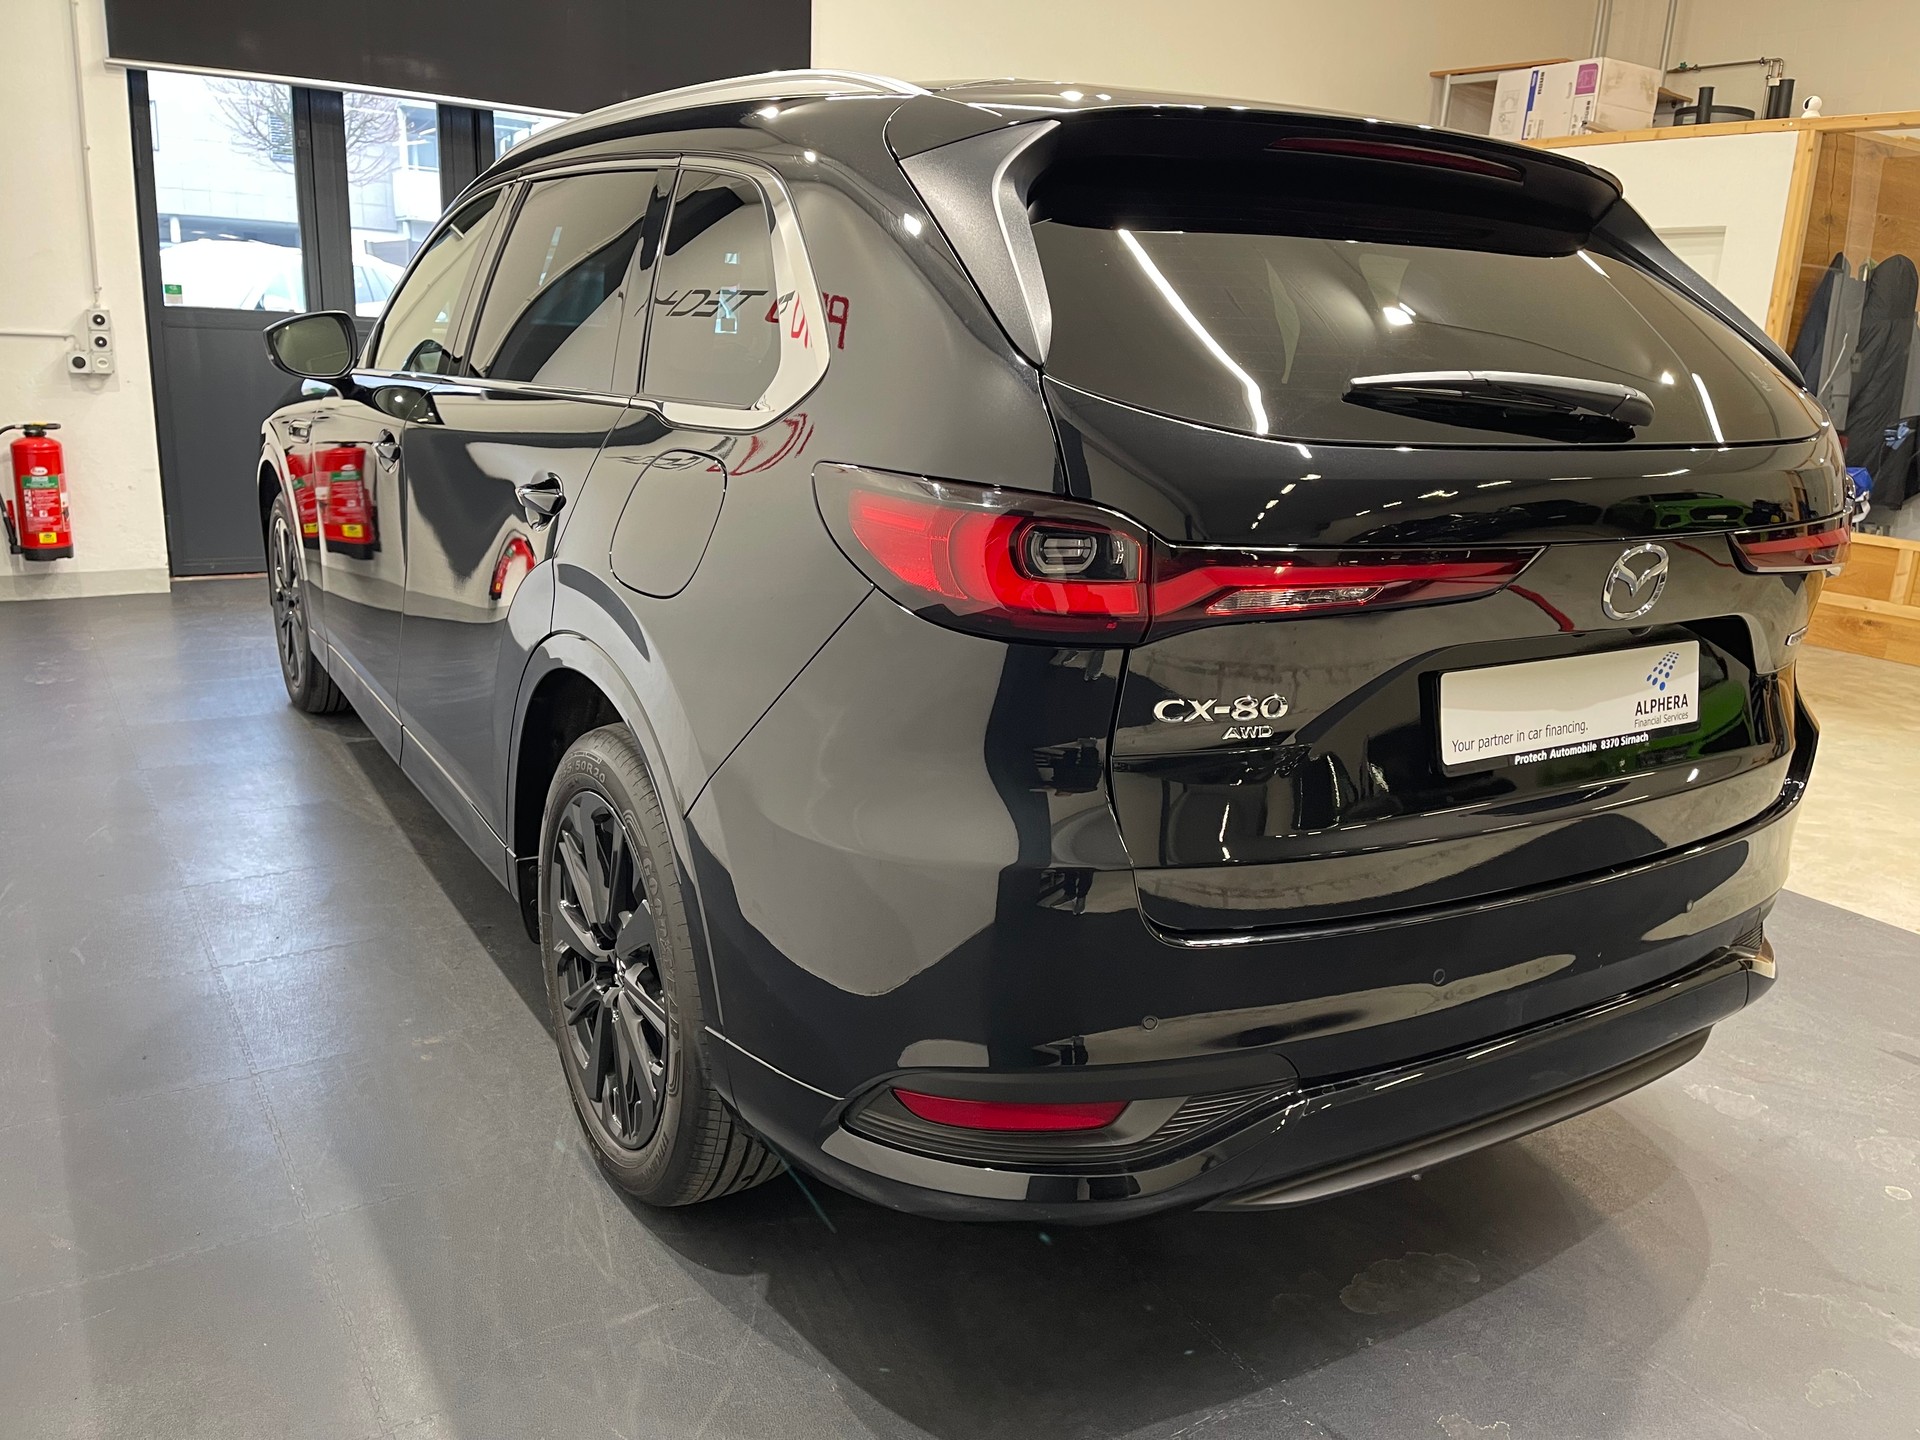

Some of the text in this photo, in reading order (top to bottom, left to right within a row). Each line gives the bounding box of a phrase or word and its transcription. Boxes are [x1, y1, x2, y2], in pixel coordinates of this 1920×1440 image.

[1153, 693, 1289, 723] CX-80
[1634, 693, 1689, 716] ALPHERA
[1222, 725, 1274, 740] AWD
[1634, 711, 1689, 729] Financial Services
[1451, 720, 1589, 753] Your partner in car financing.
[1514, 731, 1649, 766] Protech Automobile 8370 Sirnach
